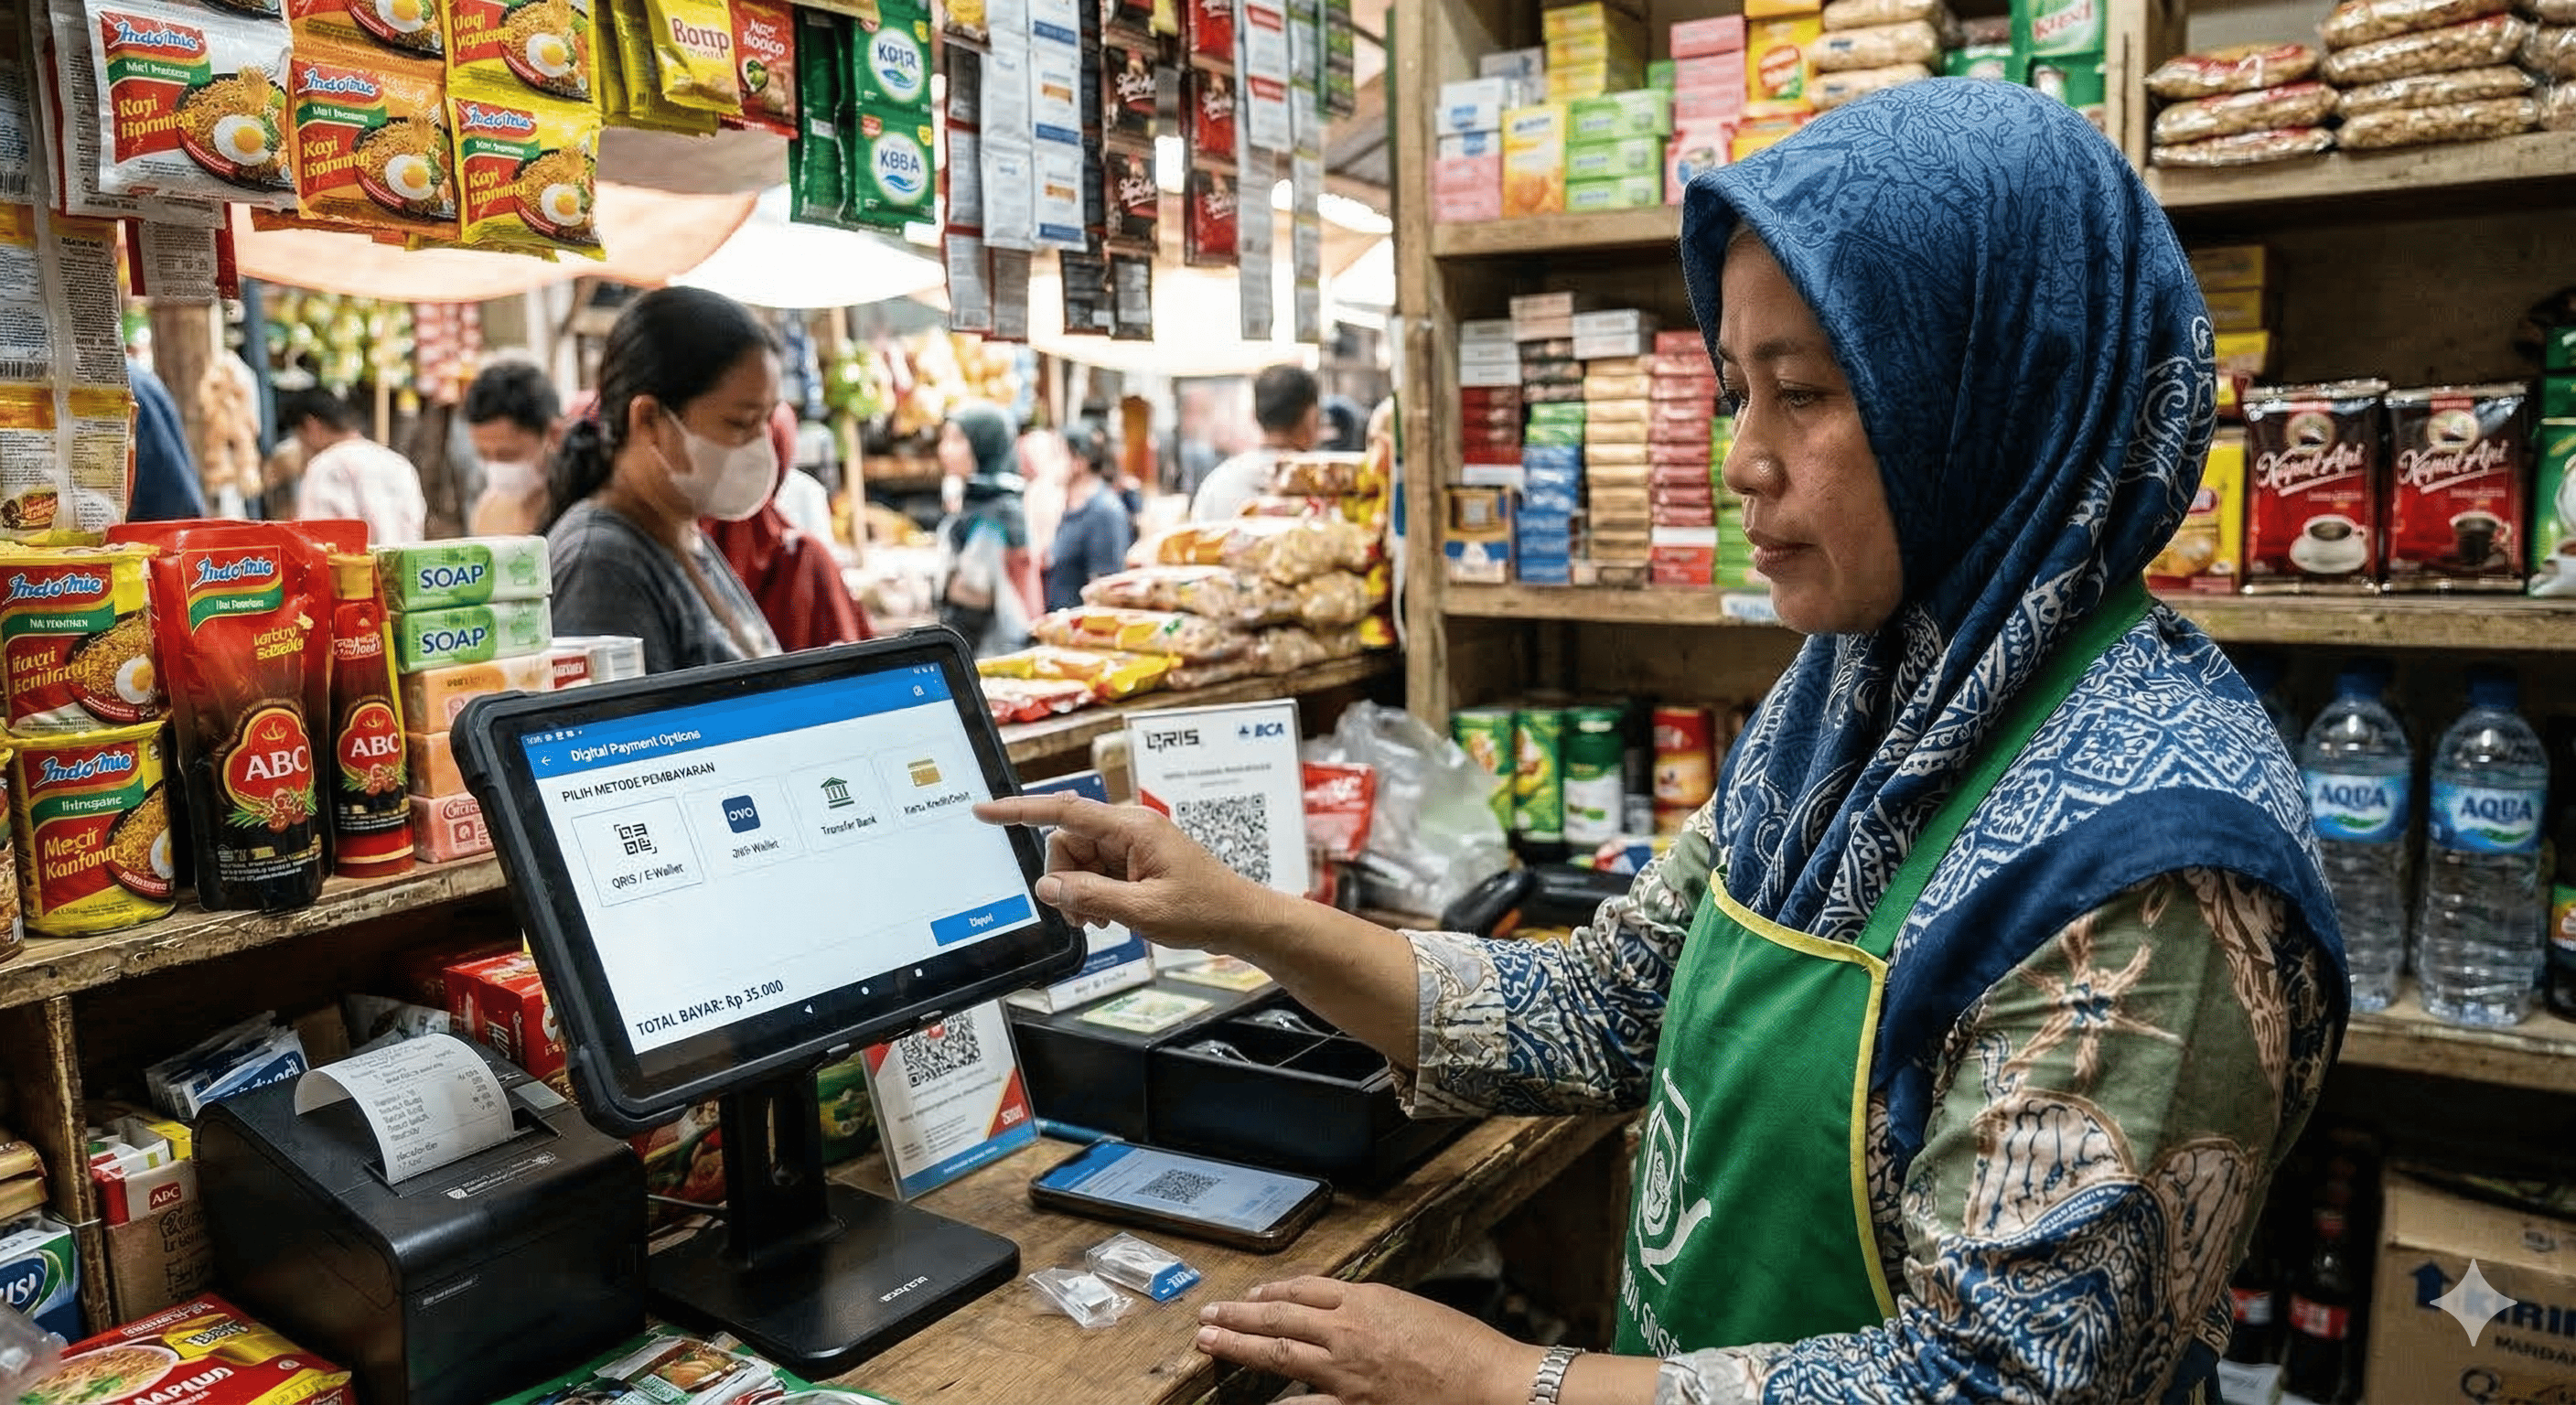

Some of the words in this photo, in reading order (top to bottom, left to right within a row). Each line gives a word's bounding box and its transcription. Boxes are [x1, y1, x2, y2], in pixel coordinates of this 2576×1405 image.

[421, 564, 484, 589] SOAP
[423, 627, 486, 653] SOAP
[350, 733, 401, 758] ABC
[609, 735, 659, 756] Payment
[244, 745, 308, 782] ABC
[562, 787, 594, 802] PILIH
[595, 777, 642, 795] METODE
[728, 807, 754, 821] OVO
[612, 874, 638, 890] QRIS
[636, 1013, 679, 1035] TOTAL
[679, 999, 725, 1024] BAYAR:
[725, 994, 744, 1010] Rp
[743, 980, 785, 1003] 35.000
